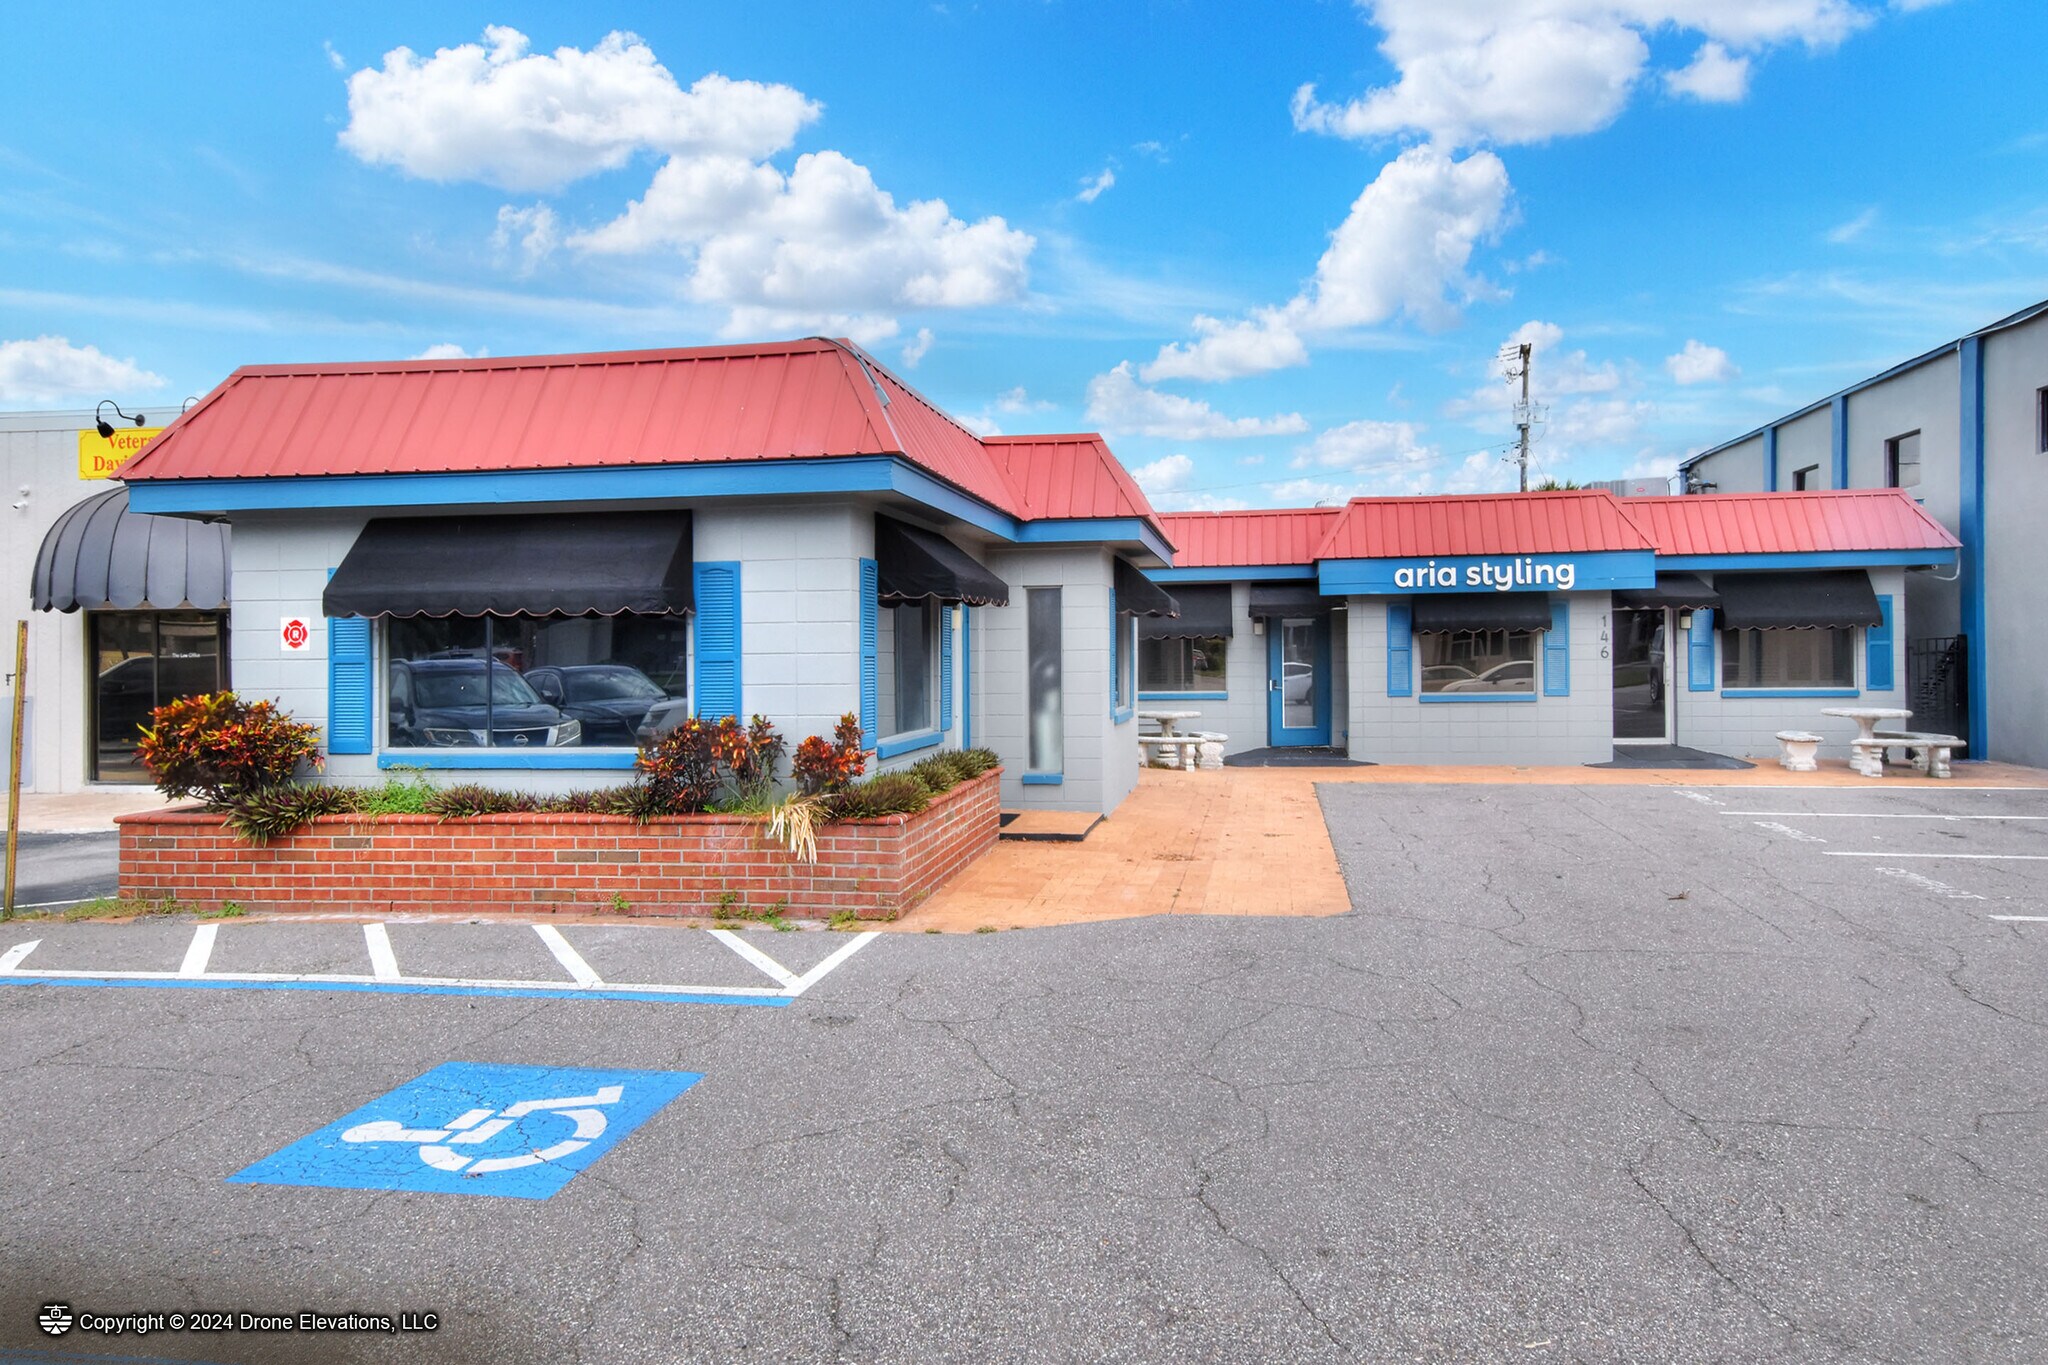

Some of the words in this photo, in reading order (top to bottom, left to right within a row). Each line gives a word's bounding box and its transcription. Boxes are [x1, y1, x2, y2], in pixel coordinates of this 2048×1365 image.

[1394, 560, 1456, 587] aria
[1466, 558, 1575, 591] styling
[292, 629, 300, 639] R
[1600, 614, 1609, 659] 146
